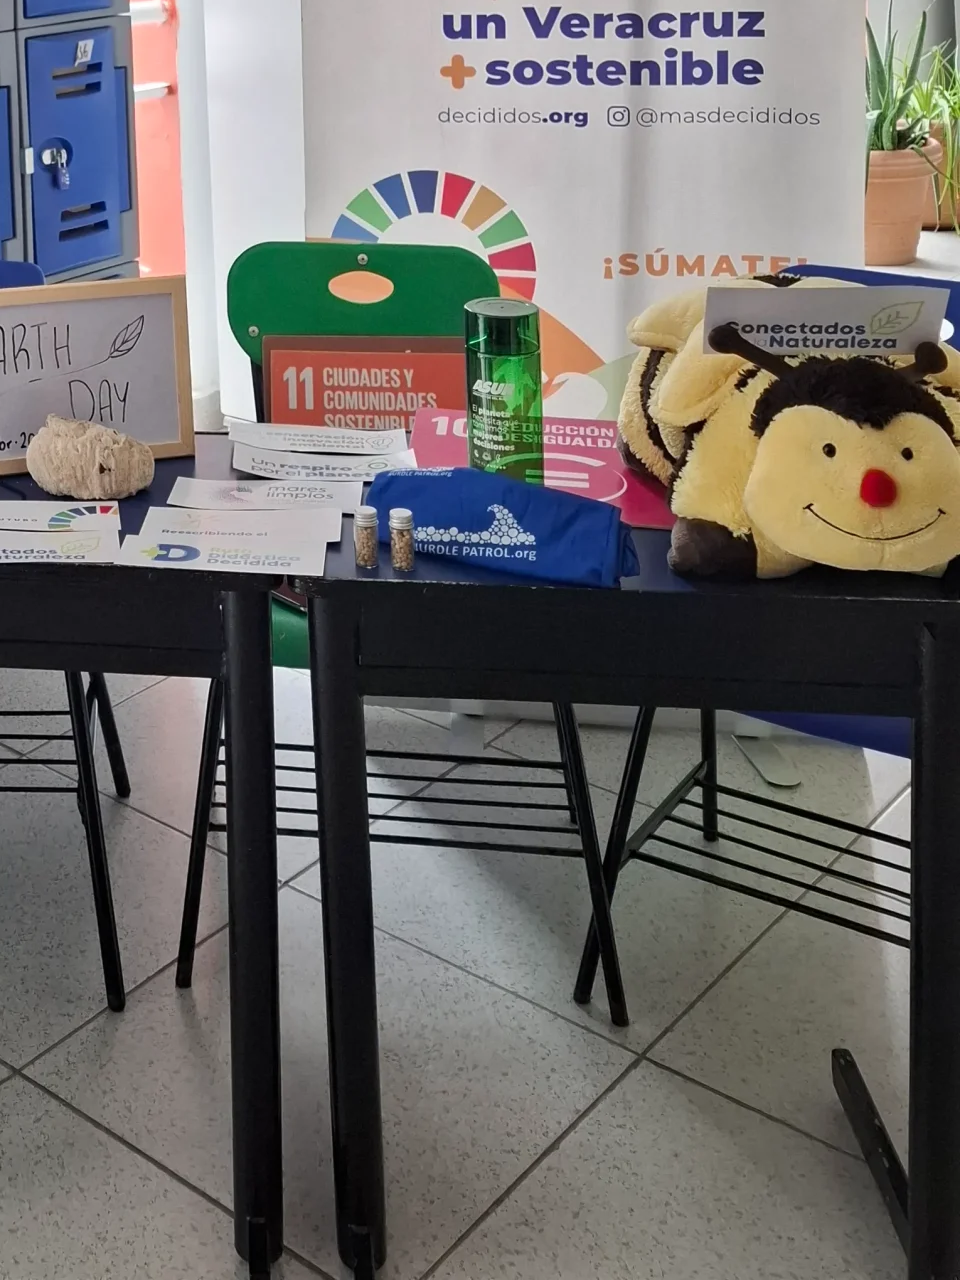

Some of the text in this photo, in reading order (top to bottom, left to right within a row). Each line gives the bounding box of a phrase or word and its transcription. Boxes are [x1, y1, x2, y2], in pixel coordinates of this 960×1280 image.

[442, 7, 766, 40] un Veracruz
[484, 48, 765, 87] sostenible
[437, 106, 820, 128] decididos.org @masdecididos
[769, 334, 897, 349] Naturaleza
[323, 367, 414, 388] CIUDADES Y
[283, 366, 315, 411] 11
[68, 379, 129, 423] DAY
[323, 390, 438, 411] COMUNIDADES
[478, 408, 511, 418] planeta
[473, 438, 515, 451] decisiones
[251, 458, 353, 472] Un respiro
[251, 465, 376, 479] por el planet
[266, 491, 334, 499] limpios
[463, 546, 537, 561] PATROL.org
[207, 558, 292, 567] Decidida
